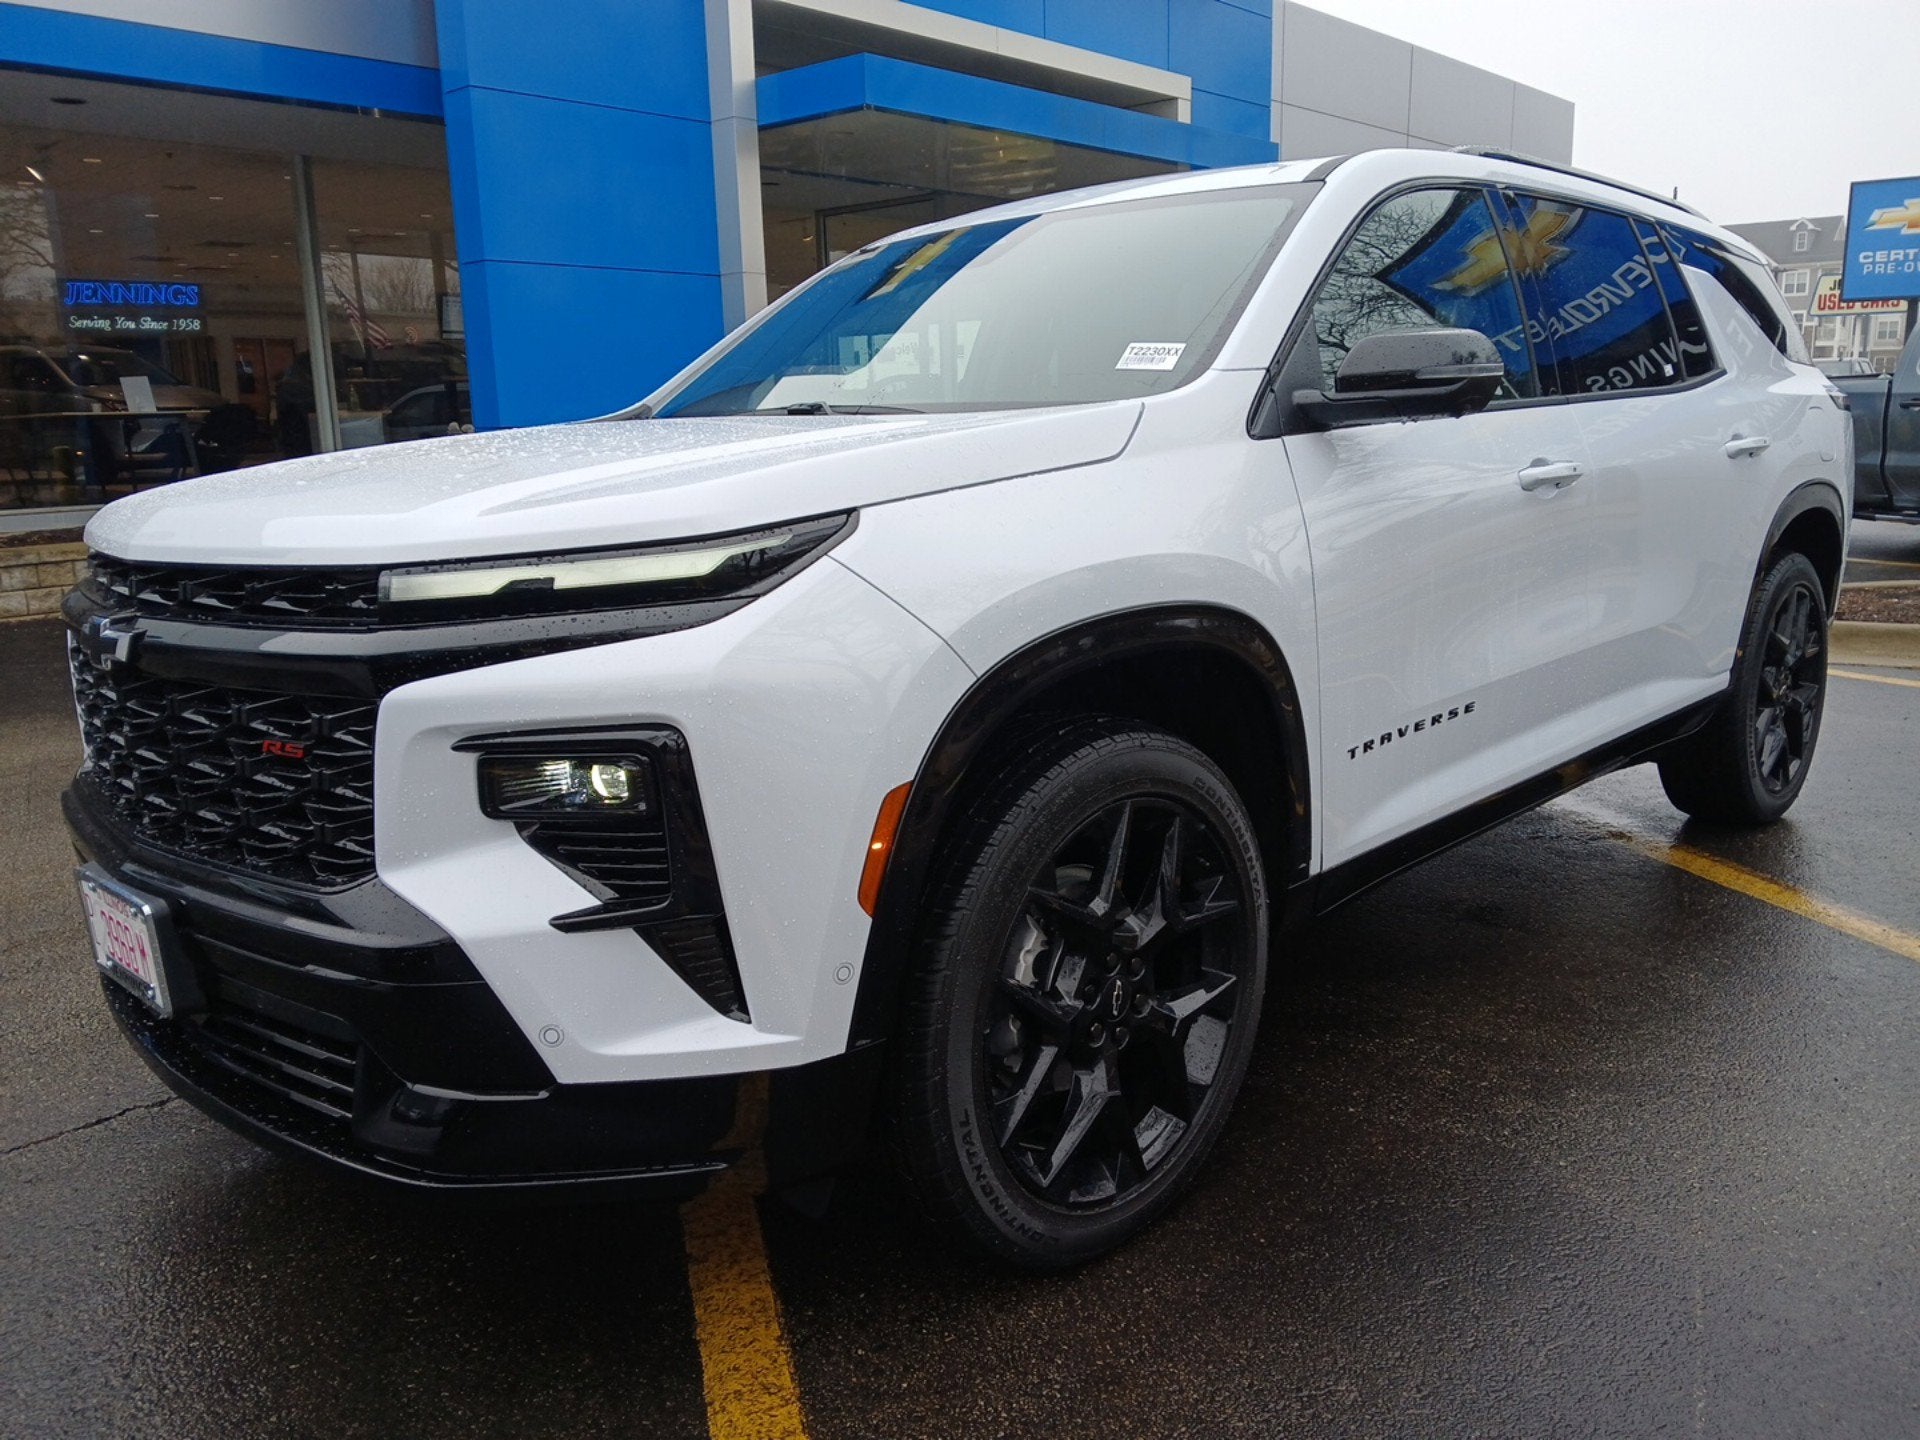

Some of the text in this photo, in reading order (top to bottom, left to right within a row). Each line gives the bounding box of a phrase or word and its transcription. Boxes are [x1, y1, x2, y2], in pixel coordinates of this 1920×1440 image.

[64, 282, 199, 305] JENNINGS
[69, 315, 201, 331] Serving You Since 1958
[1128, 346, 1182, 357] T2230XX
[1346, 700, 1477, 760] TRAVERSE
[262, 740, 305, 759] RS
